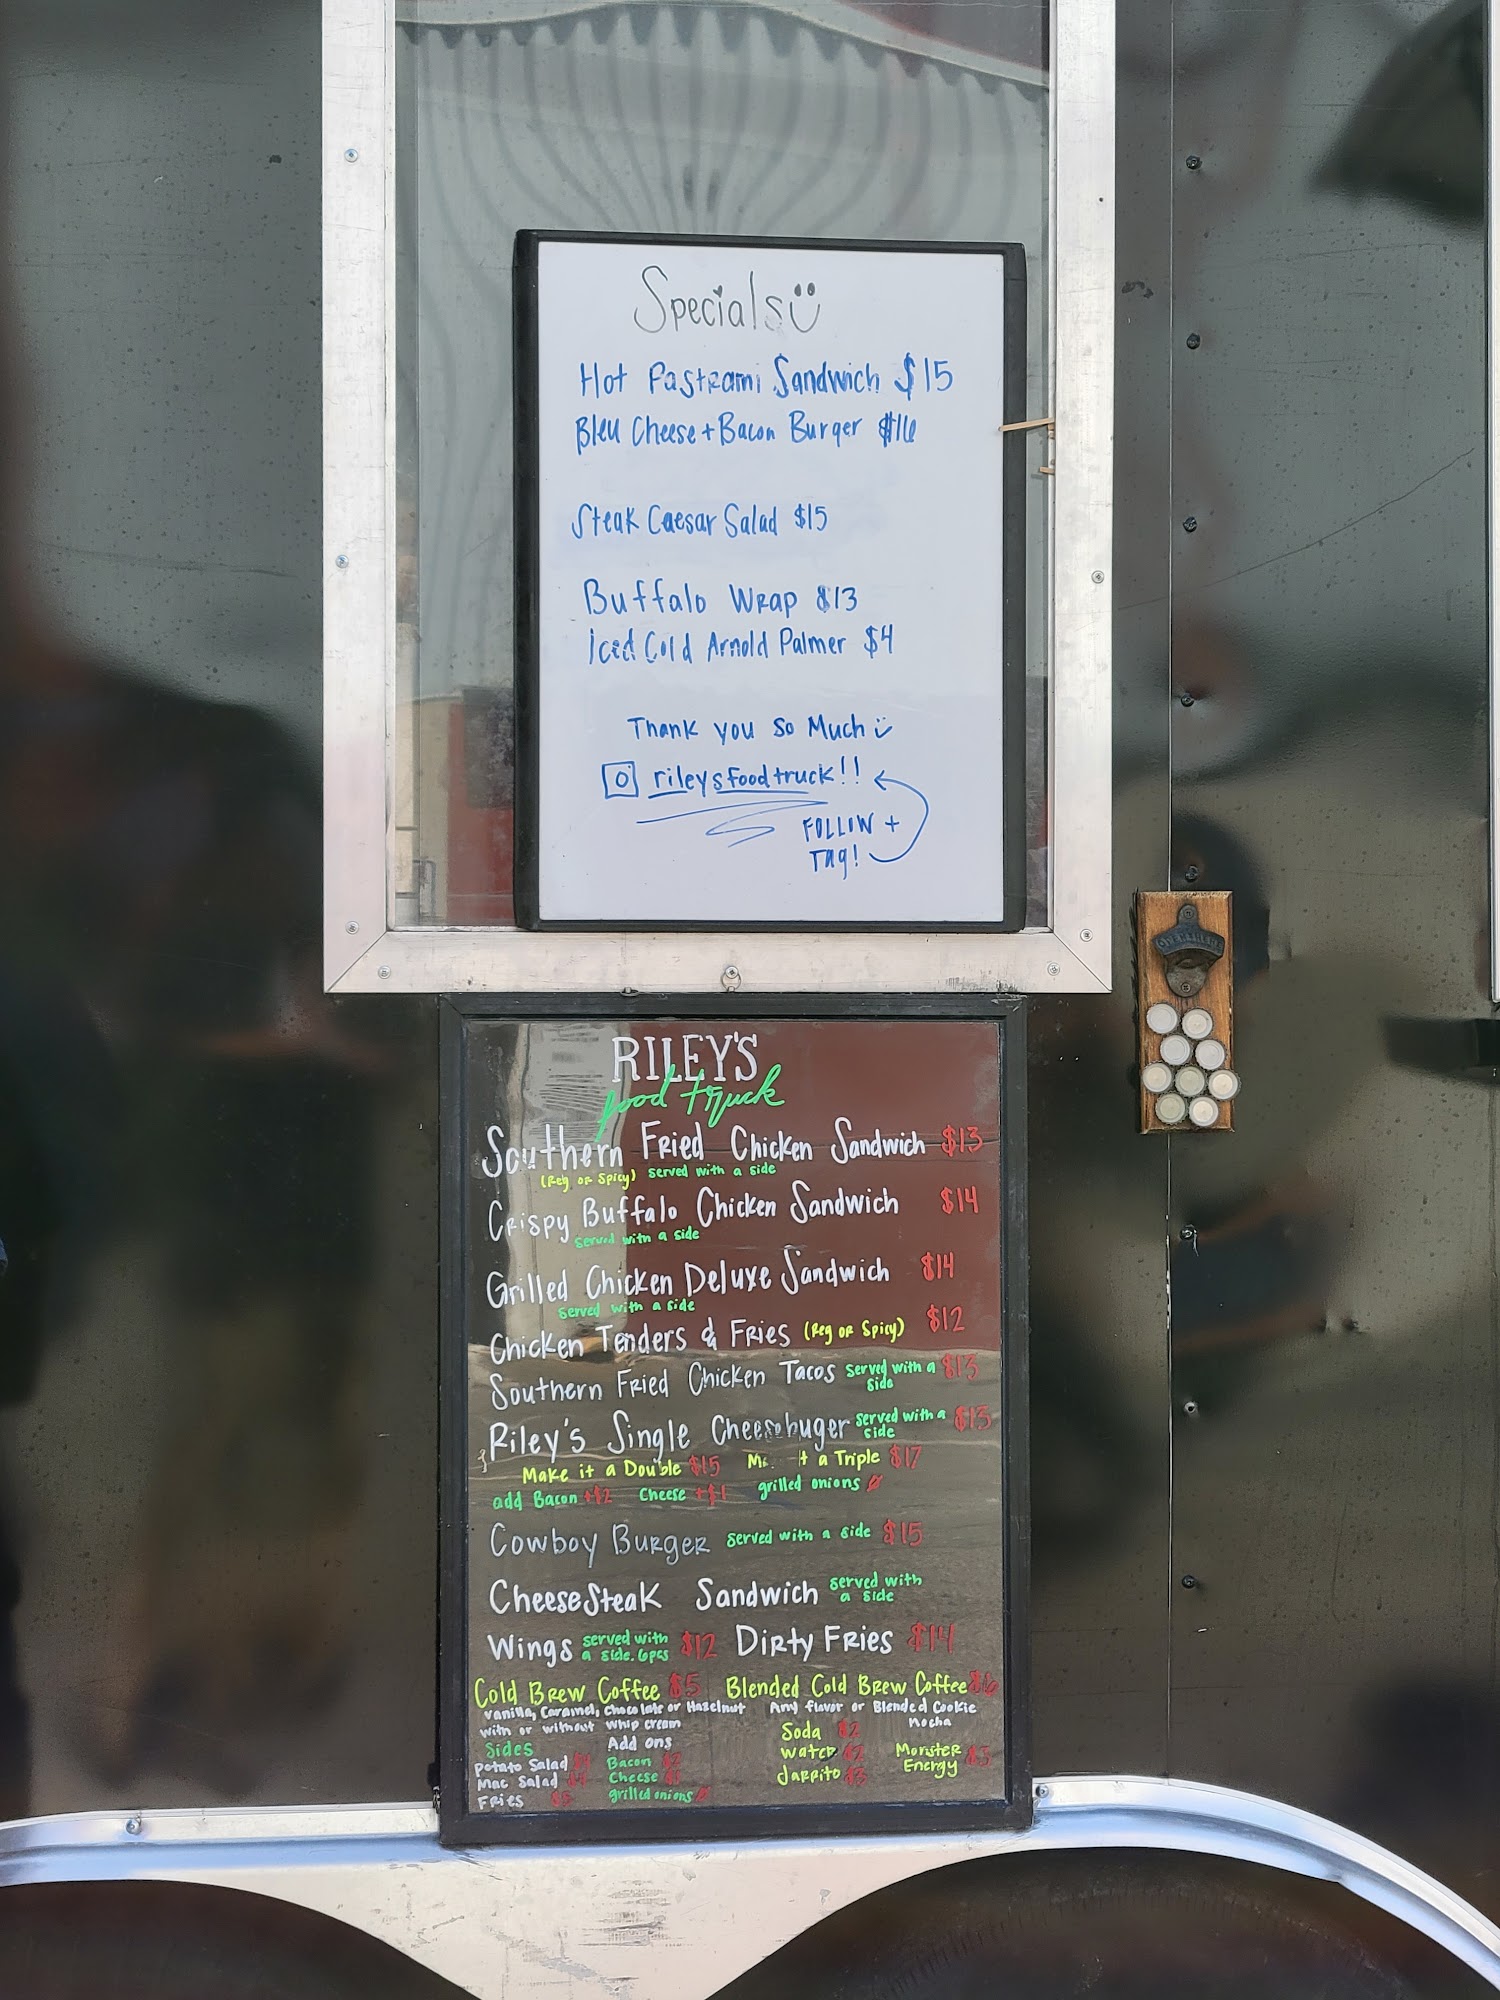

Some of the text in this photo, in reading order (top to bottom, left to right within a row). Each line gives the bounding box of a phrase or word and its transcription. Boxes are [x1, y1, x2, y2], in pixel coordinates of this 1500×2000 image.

[580, 362, 627, 398] Hot
[773, 353, 881, 397] Sandwich
[894, 353, 953, 400] $15
[790, 410, 863, 449] Burger
[572, 504, 828, 539] Steak Caesar Salad $15
[584, 579, 707, 614] Buffalo
[729, 584, 798, 618] Wrap
[645, 631, 692, 663] Cold
[707, 631, 768, 662] Arnold
[780, 627, 847, 656] Palmer
[864, 624, 894, 658] $4
[627, 717, 699, 739] Thank
[714, 723, 755, 745] you
[808, 714, 865, 739] Much
[611, 1032, 757, 1082] RILEY'S
[594, 1064, 676, 1142] food
[482, 1117, 983, 1178] Southern Fried Chicken Sandwich $13
[649, 1162, 776, 1178] served with a side
[489, 1180, 979, 1243] Crispy Buffalo Chicken Sandwich $14
[659, 1231, 667, 1241] a
[674, 1226, 699, 1240] side
[487, 1244, 954, 1309] Grilled Chicken Deluxe Sandwich $14
[558, 1299, 695, 1320] served with a side
[491, 1330, 583, 1365] Chicken
[595, 1325, 687, 1354] Tenders
[730, 1319, 791, 1347] Fries
[926, 1303, 965, 1332] $12
[490, 1373, 603, 1410] Southern
[618, 1368, 668, 1398] Fried
[688, 1361, 766, 1396] Chicken
[779, 1359, 836, 1384] Tacos
[845, 1359, 887, 1377] served
[892, 1361, 922, 1373] with
[490, 1418, 586, 1463] Riley's
[607, 1410, 691, 1462] Single
[856, 1407, 898, 1426] served
[903, 1408, 933, 1422] with
[864, 1426, 895, 1439] side
[523, 1455, 720, 1484] Make it a Double $15
[818, 1444, 922, 1471] a Triple $17
[492, 1490, 578, 1510] add Bacon
[639, 1487, 686, 1502] Cheese
[758, 1475, 861, 1500] grilled onions
[491, 1519, 923, 1568] Cowboy Burger served with a side $15
[696, 1577, 818, 1611] Sandwich
[829, 1571, 879, 1591] served
[884, 1573, 923, 1586] with
[840, 1588, 894, 1603] a side
[487, 1629, 718, 1668] Wings served with $12
[582, 1650, 591, 1662] a
[736, 1622, 955, 1662] Dirty Fries $14
[474, 1672, 701, 1709] Cold Brew Coffee $5
[726, 1673, 799, 1699] Blended
[811, 1673, 847, 1698] Cold
[858, 1673, 907, 1696] Brew
[915, 1670, 968, 1696] Coffee
[667, 1703, 681, 1712] or
[607, 1735, 637, 1751] Add
[781, 1720, 821, 1741] Soda
[485, 1740, 533, 1758] Sides
[529, 1755, 568, 1772] Salad
[607, 1756, 652, 1770] Bacon
[518, 1771, 558, 1788] Salad
[608, 1772, 658, 1783] Cheese
